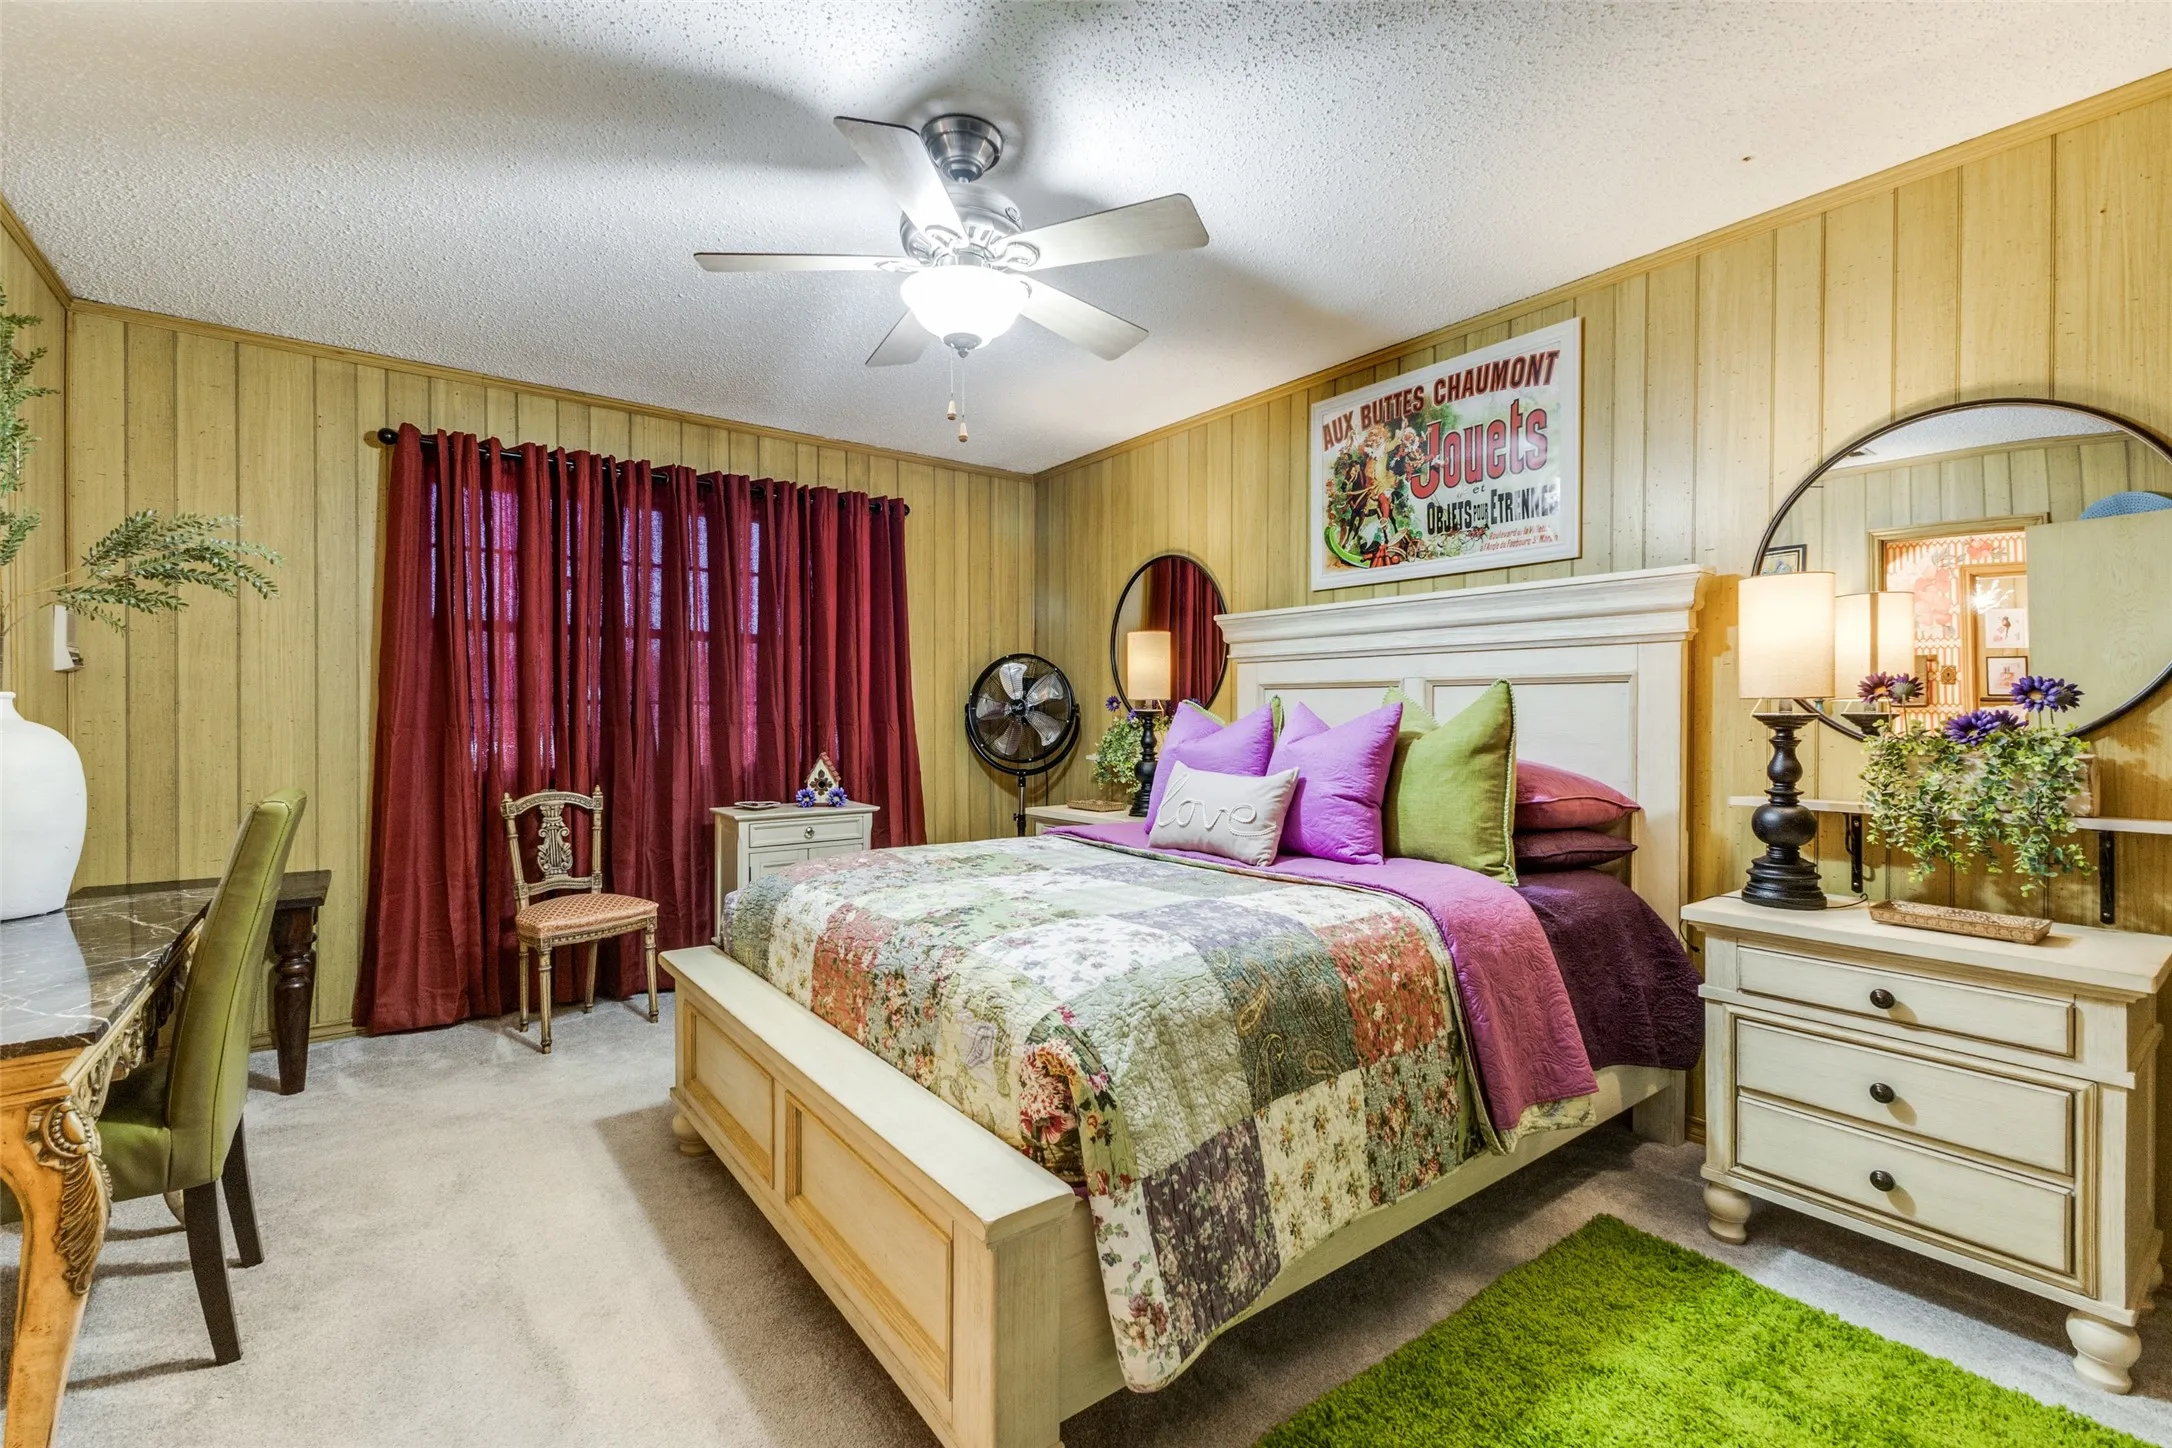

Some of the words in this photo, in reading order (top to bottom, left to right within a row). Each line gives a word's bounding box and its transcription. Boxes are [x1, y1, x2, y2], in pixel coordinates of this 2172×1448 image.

[1322, 410, 1354, 452] AUX
[1360, 384, 1425, 431] BUTTES
[1433, 350, 1560, 407] CHAUMONT
[1410, 399, 1547, 499] Jouets
[1427, 500, 1472, 535] OBJETS
[1473, 503, 1489, 522] POUR
[1472, 484, 1485, 494] et
[1158, 773, 1277, 837] love
